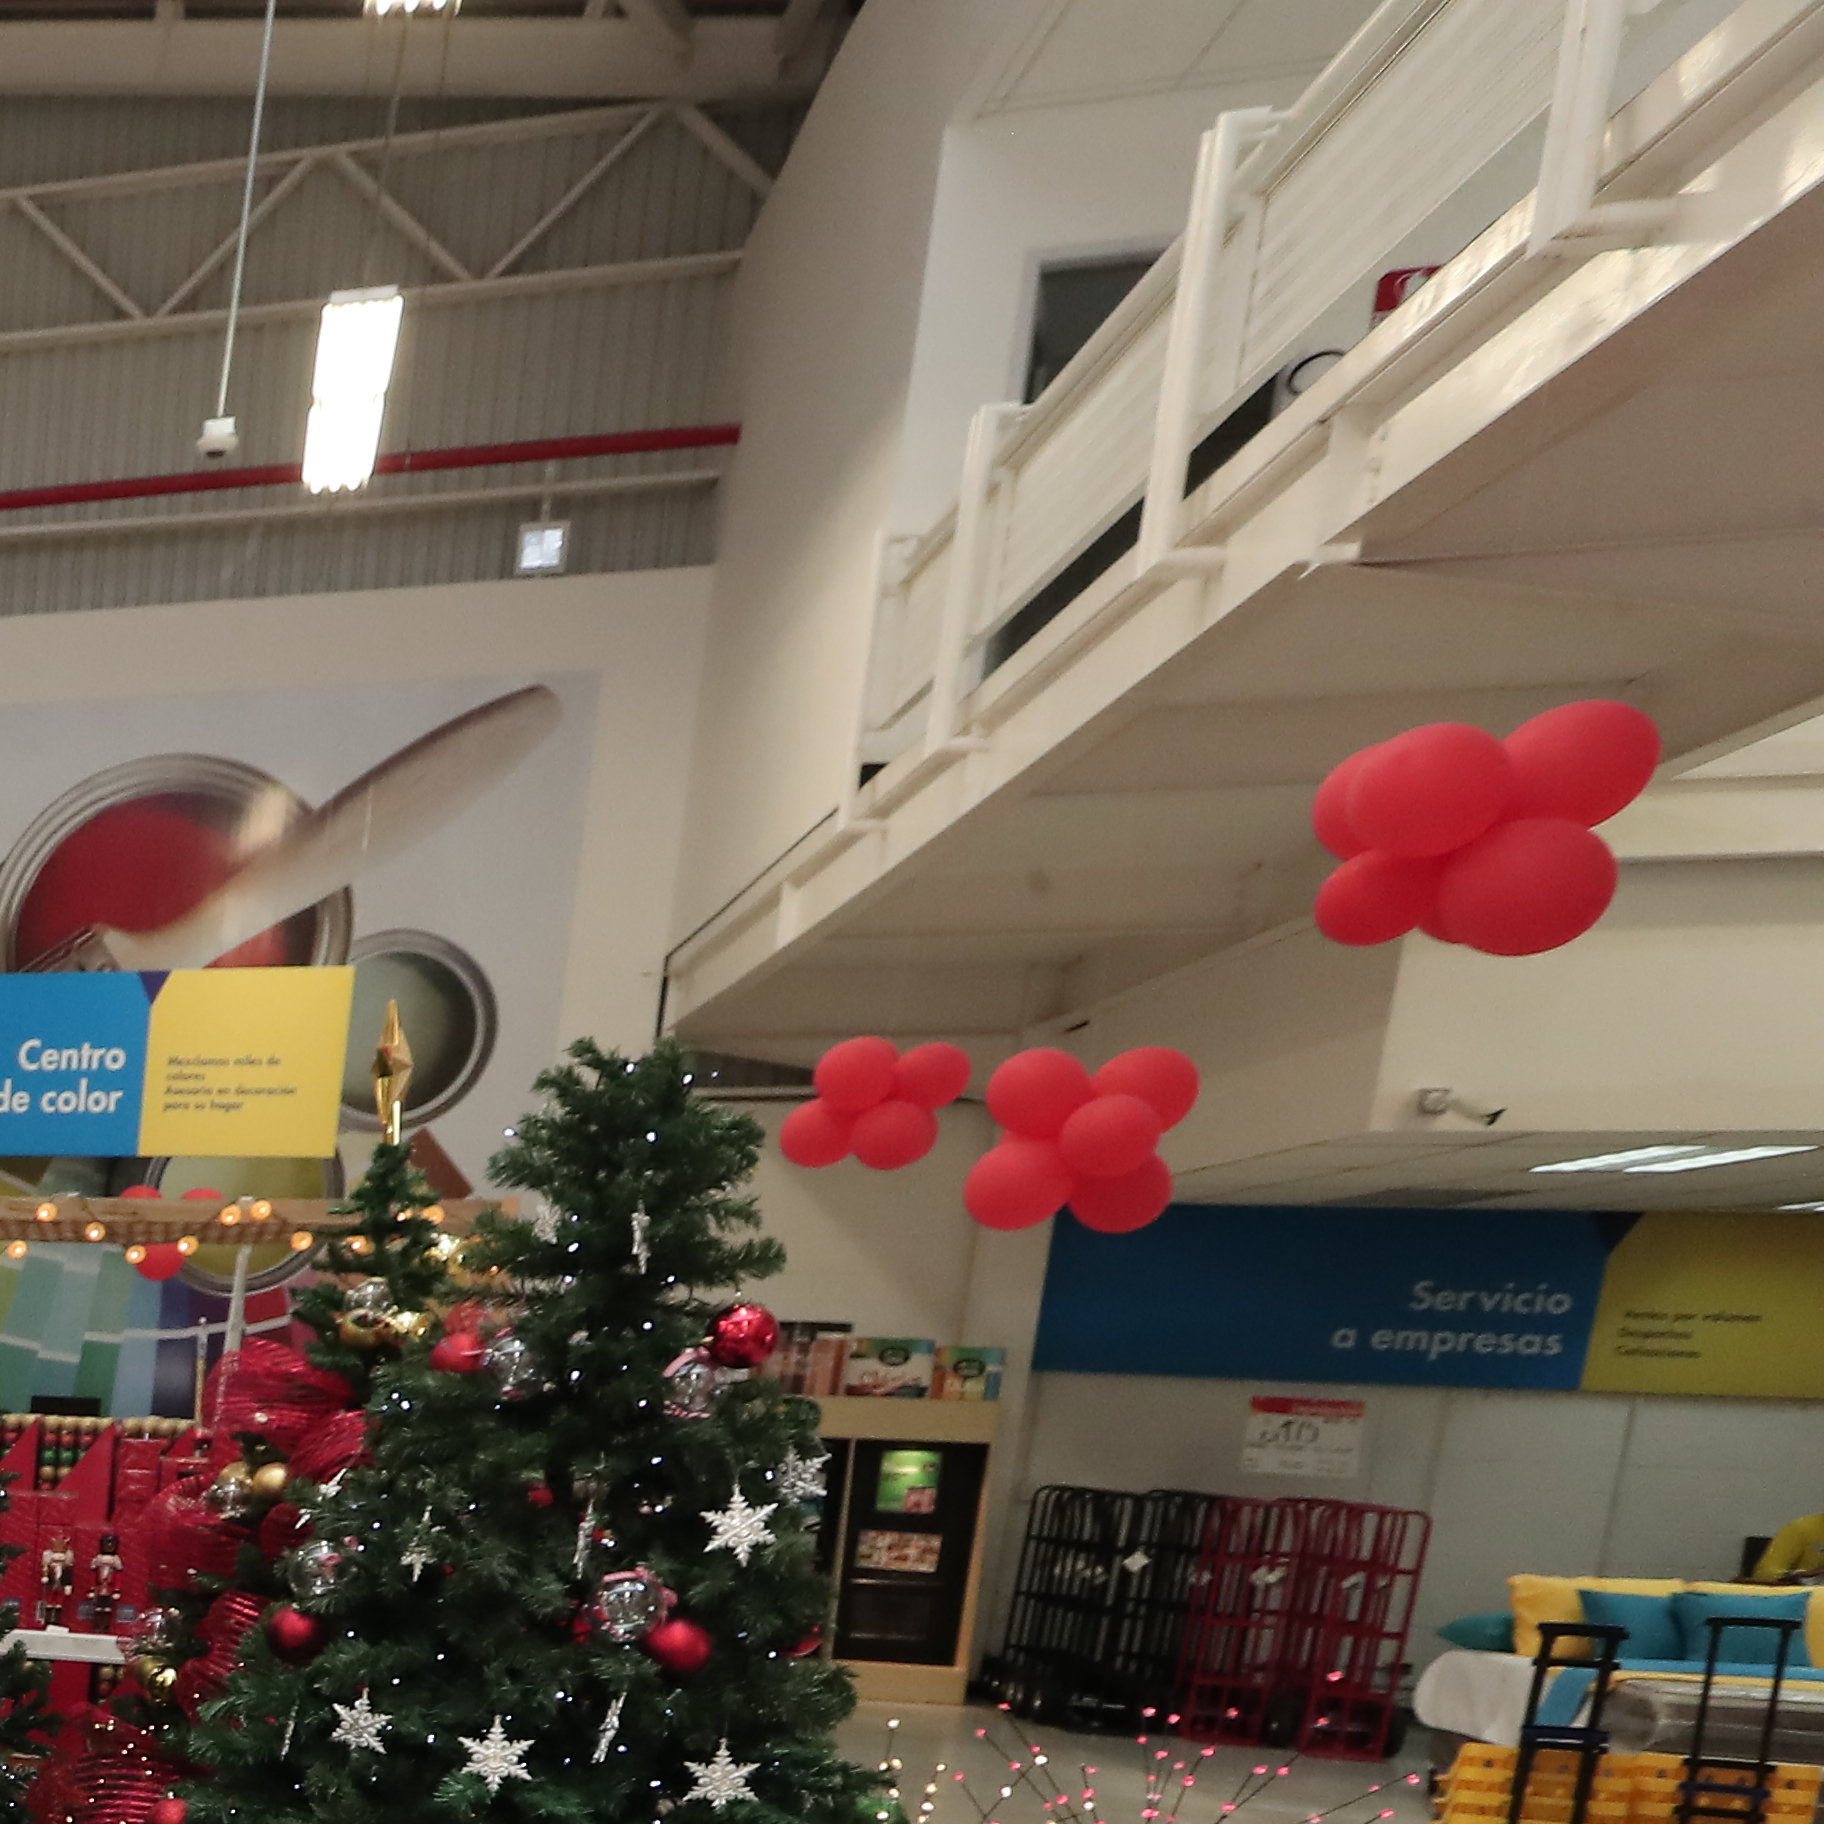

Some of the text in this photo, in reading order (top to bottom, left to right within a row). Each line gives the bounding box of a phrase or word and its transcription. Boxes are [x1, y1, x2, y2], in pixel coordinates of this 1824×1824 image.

[17, 1038, 127, 1072] Centro
[40, 1077, 125, 1114] color
[1408, 1280, 1574, 1316] Servicio
[1331, 1327, 1565, 1361] a empresas
